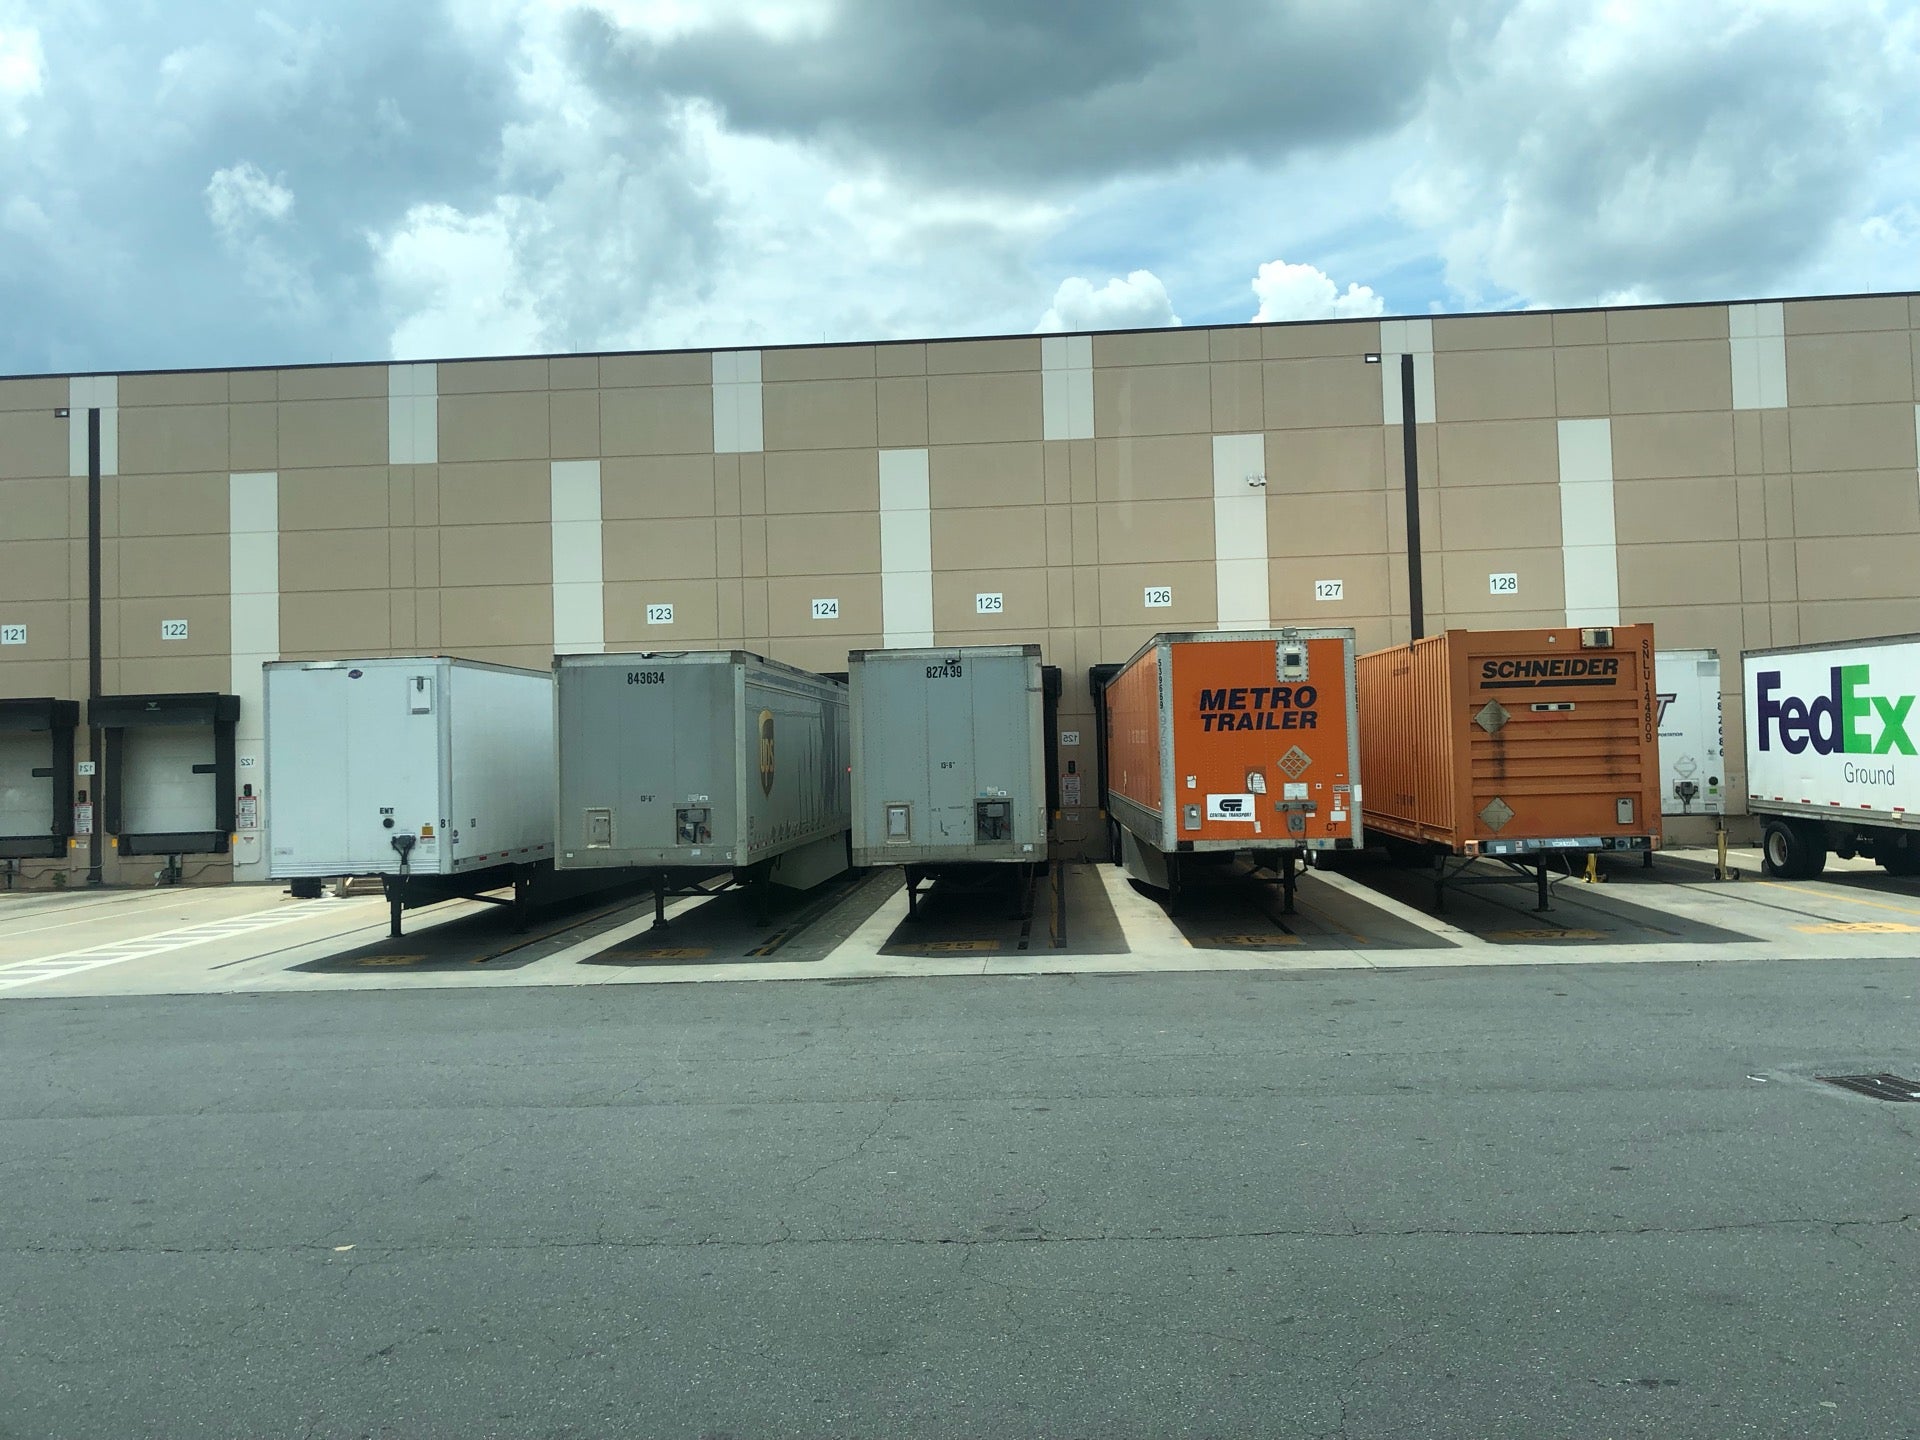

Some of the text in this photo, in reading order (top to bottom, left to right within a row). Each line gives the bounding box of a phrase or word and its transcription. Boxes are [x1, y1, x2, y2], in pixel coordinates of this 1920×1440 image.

[1491, 577, 1516, 590] 128
[1146, 590, 1170, 603] 126
[1317, 584, 1341, 597] 127
[814, 603, 837, 615] 124
[978, 597, 1002, 610] 125
[649, 608, 672, 621] 123
[4, 628, 26, 641] 121
[163, 623, 186, 636] 122
[926, 665, 962, 679] 827439
[1482, 658, 1619, 679] SCHNEIDER
[627, 671, 665, 685] 843634
[1642, 639, 1652, 743] SNLU144809
[1200, 686, 1318, 711] METRO
[1757, 664, 1919, 756] FedEx
[1200, 711, 1318, 732] TRAILER
[760, 738, 774, 773] UPS
[1844, 762, 1895, 786] Ground
[1326, 823, 1339, 832] CT
